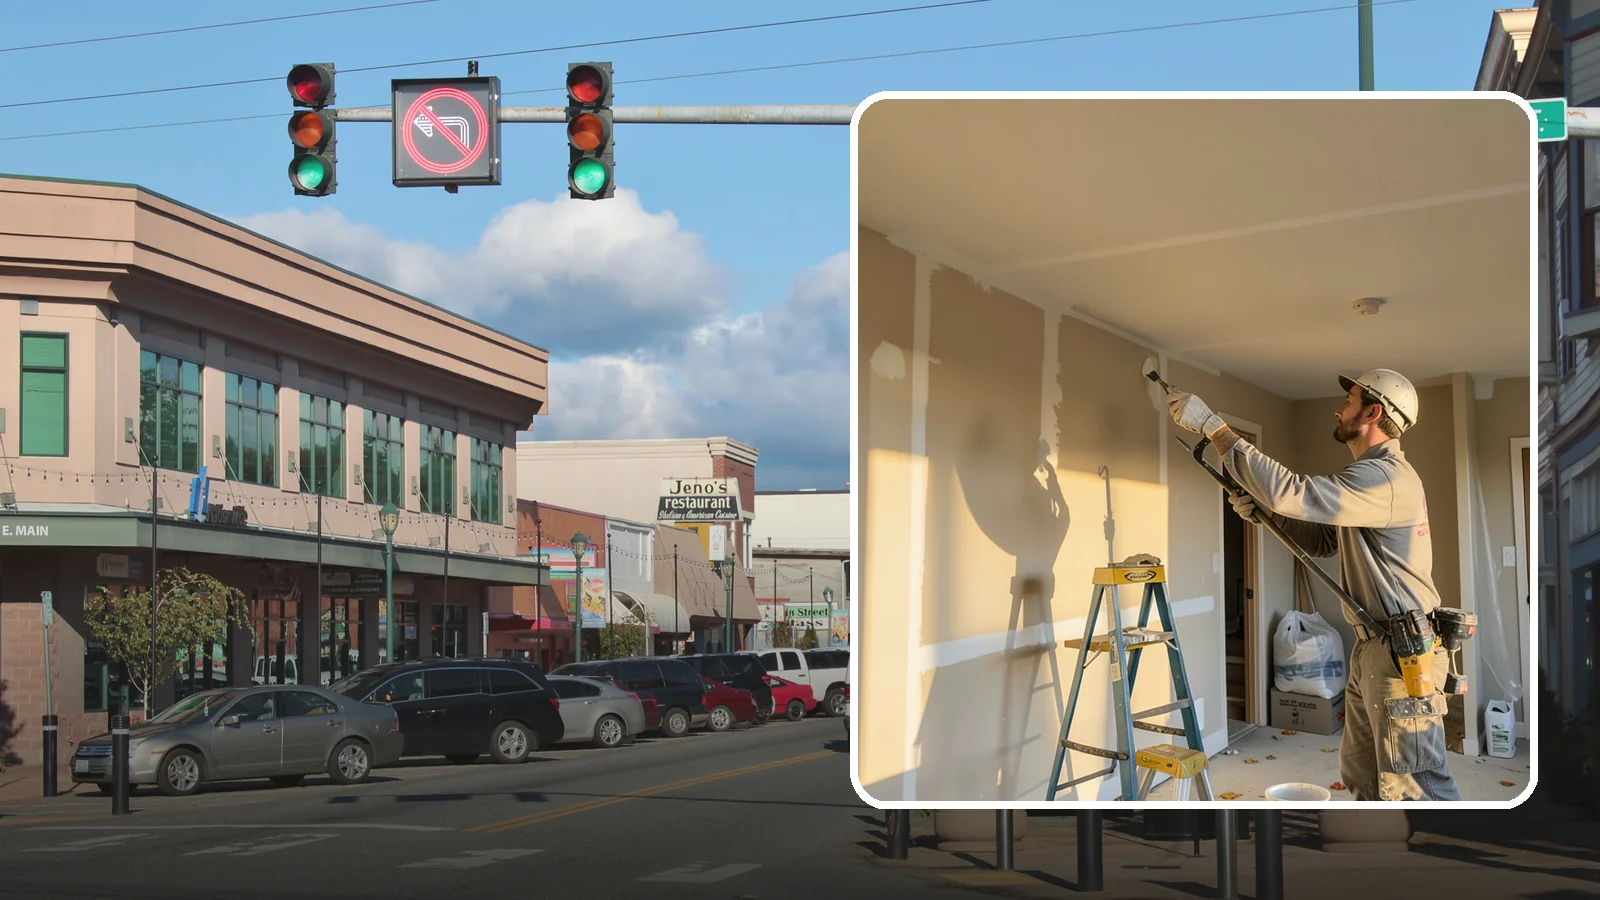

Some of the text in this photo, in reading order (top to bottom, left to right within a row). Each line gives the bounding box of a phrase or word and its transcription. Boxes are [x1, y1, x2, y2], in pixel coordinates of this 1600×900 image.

[669, 480, 728, 494] Jeno's
[665, 496, 731, 509] restaurant
[659, 510, 681, 520] Italian
[686, 510, 714, 520] American
[715, 510, 737, 519] Cuisine
[2, 525, 49, 536] E. MAIN
[797, 608, 828, 617] Street
